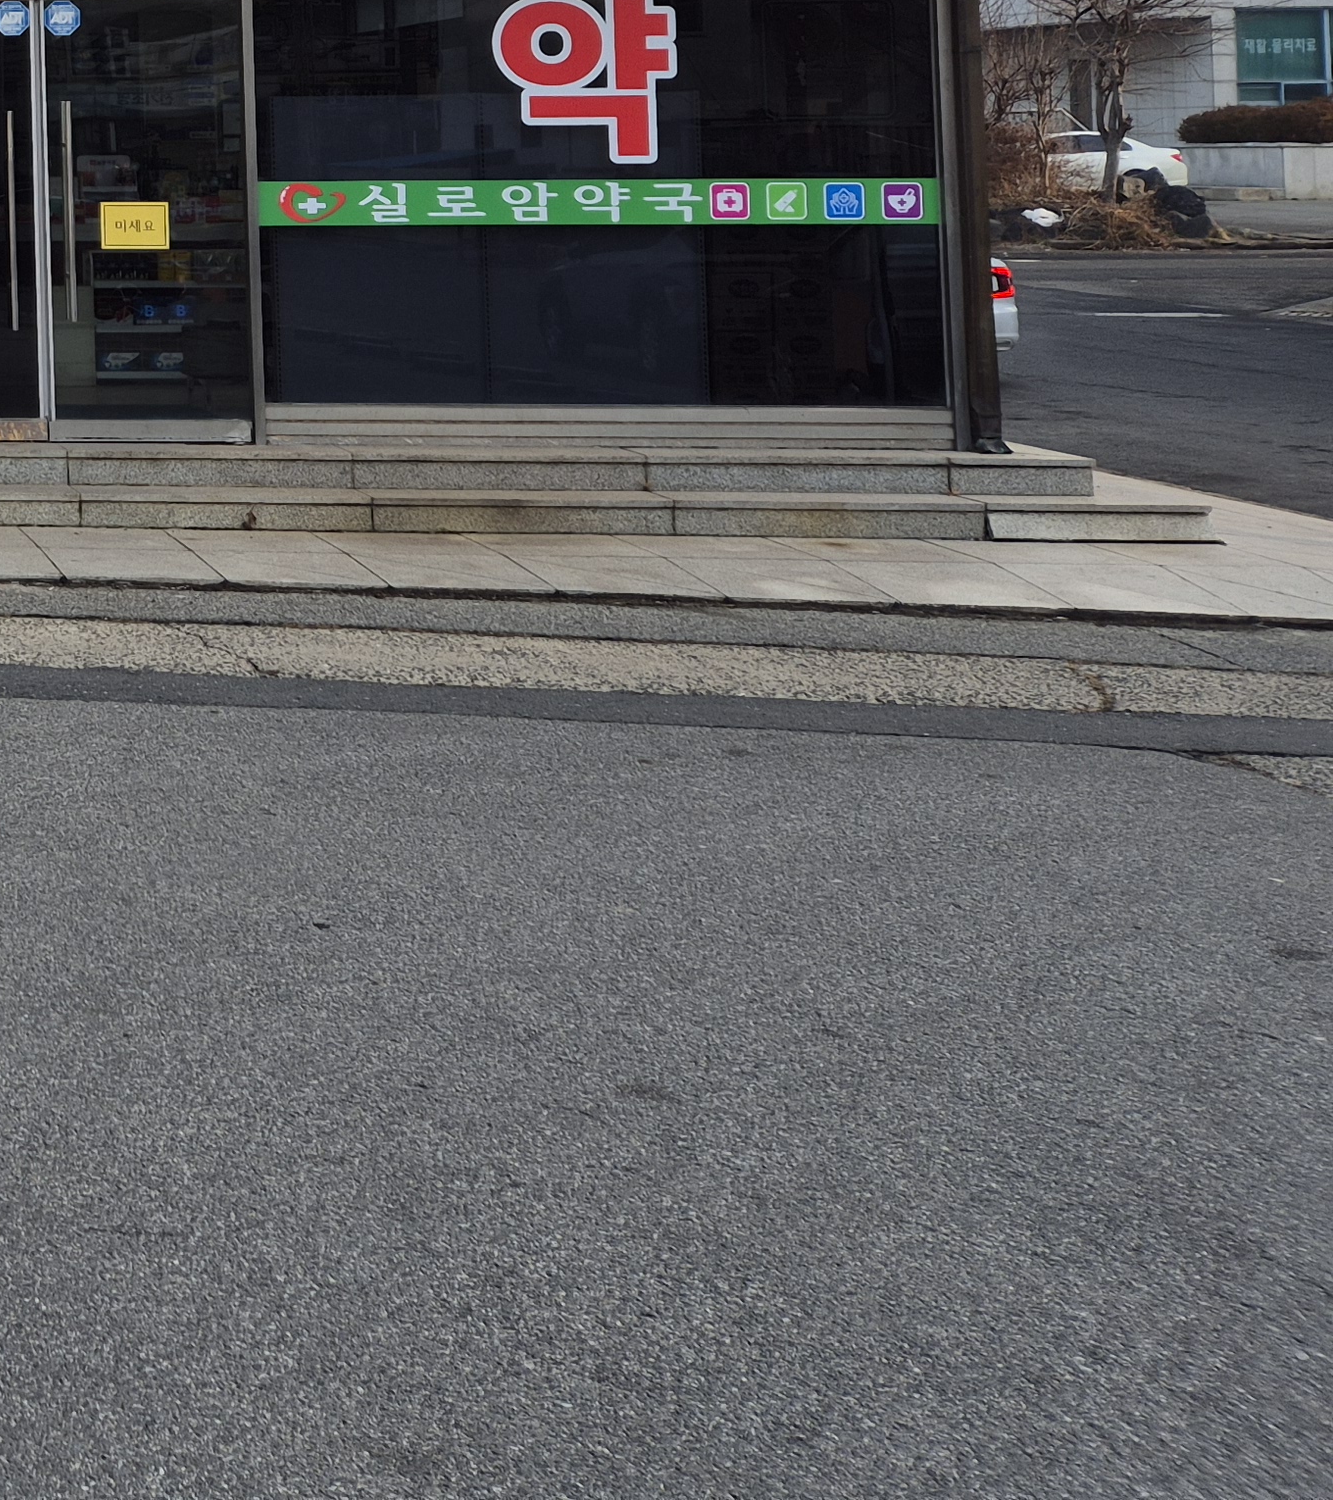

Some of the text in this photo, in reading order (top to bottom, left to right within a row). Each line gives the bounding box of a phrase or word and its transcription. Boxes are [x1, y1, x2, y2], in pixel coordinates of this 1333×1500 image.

[0, 12, 24, 26] ADT
[50, 12, 75, 25] ADT
[359, 182, 703, 223] 실로암약국
[114, 219, 156, 233] 미세요
